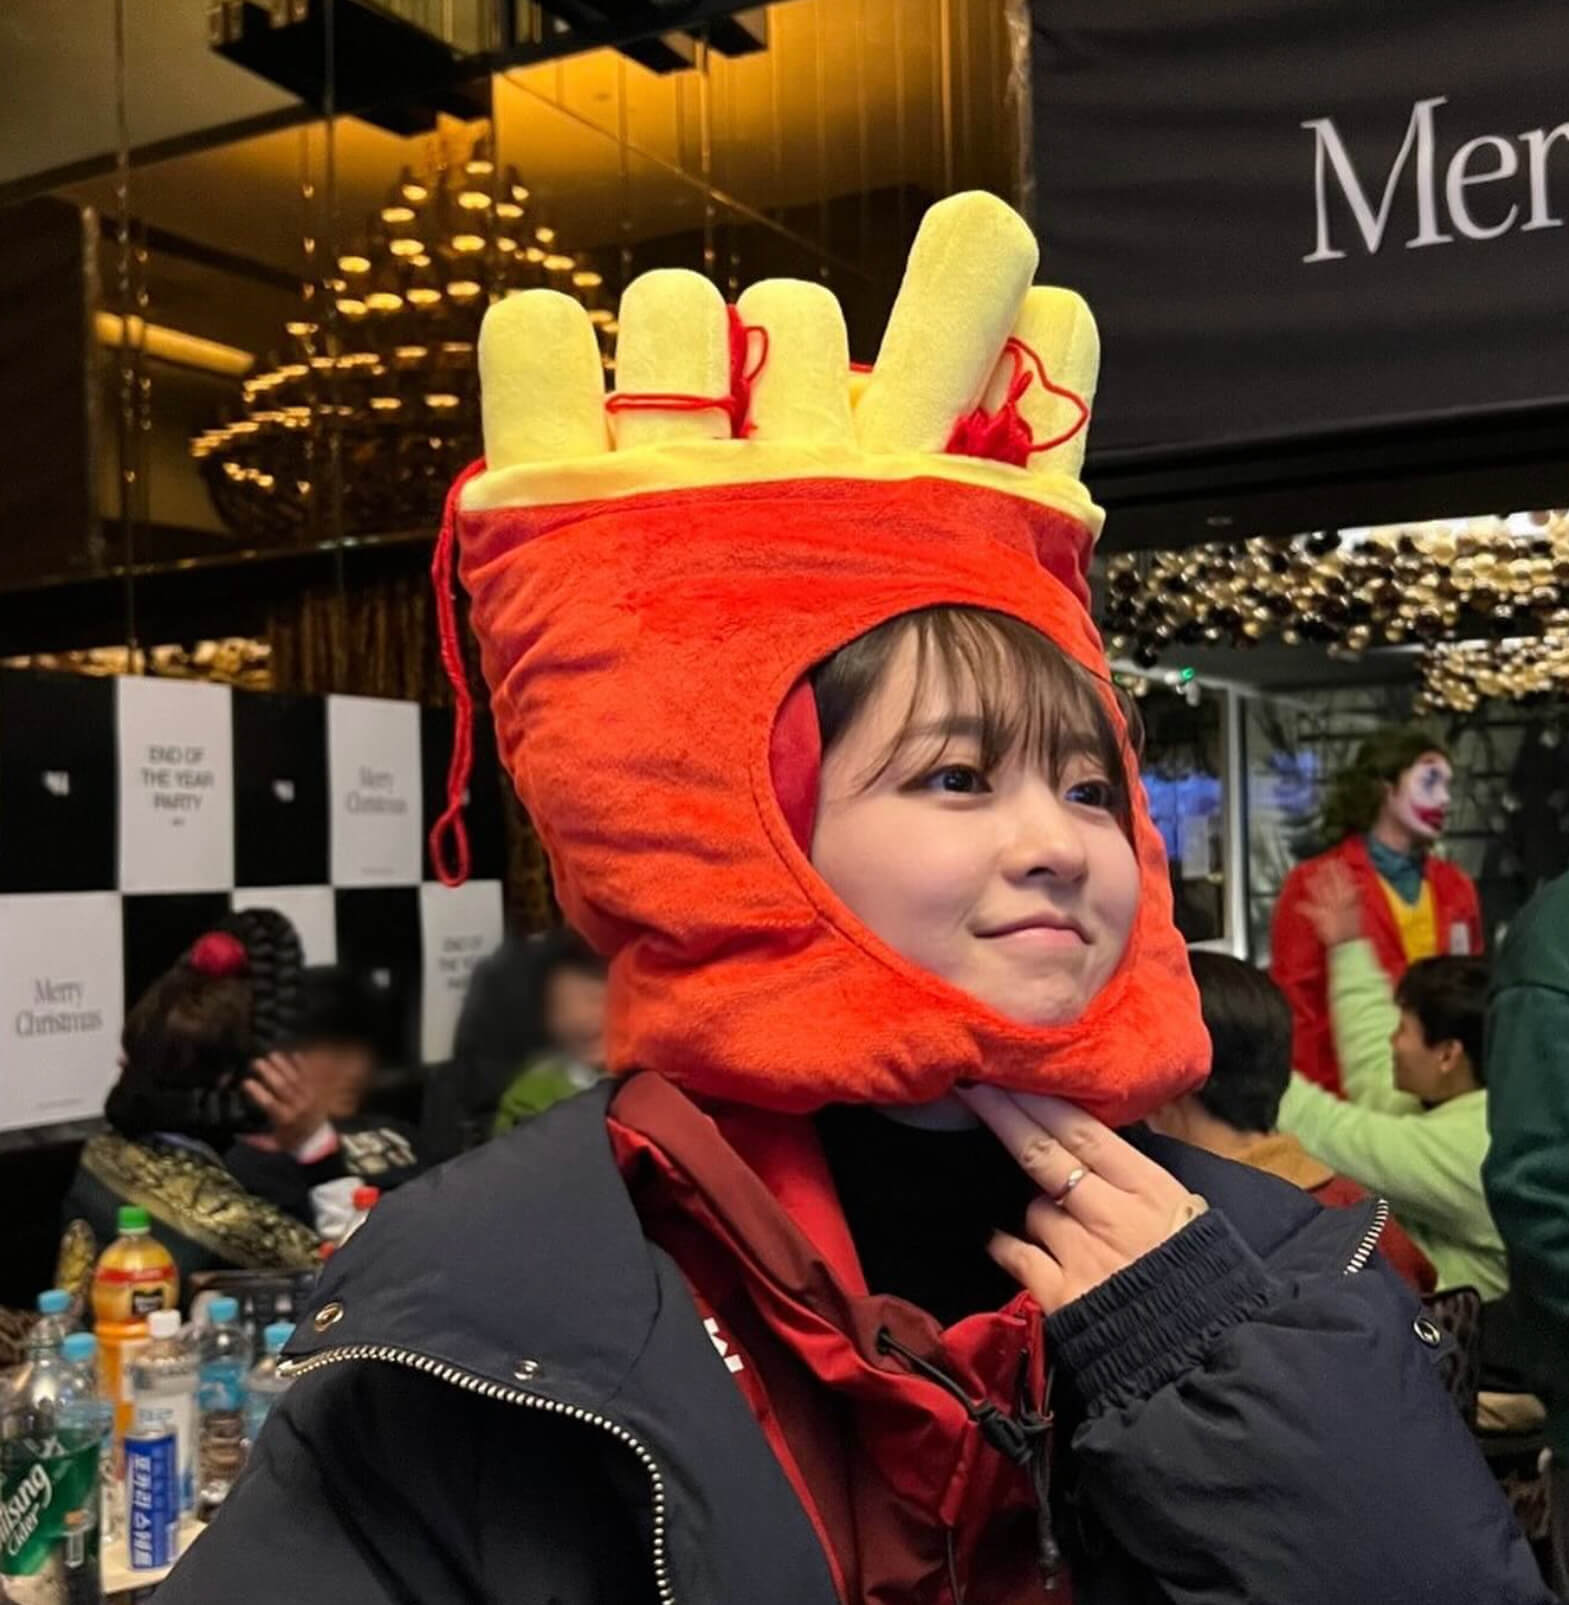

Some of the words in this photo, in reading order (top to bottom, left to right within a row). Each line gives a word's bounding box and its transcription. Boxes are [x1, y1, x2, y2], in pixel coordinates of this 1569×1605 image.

[1300, 96, 1569, 263] Mer
[148, 745, 182, 765] END
[185, 746, 205, 765] OF
[141, 767, 171, 789] THE
[175, 769, 215, 790] YEAR
[359, 765, 394, 795] Merry
[153, 791, 202, 812] PARTY
[345, 790, 408, 816] Christmas
[33, 978, 82, 1008] Merry
[15, 1010, 103, 1038] Christmas
